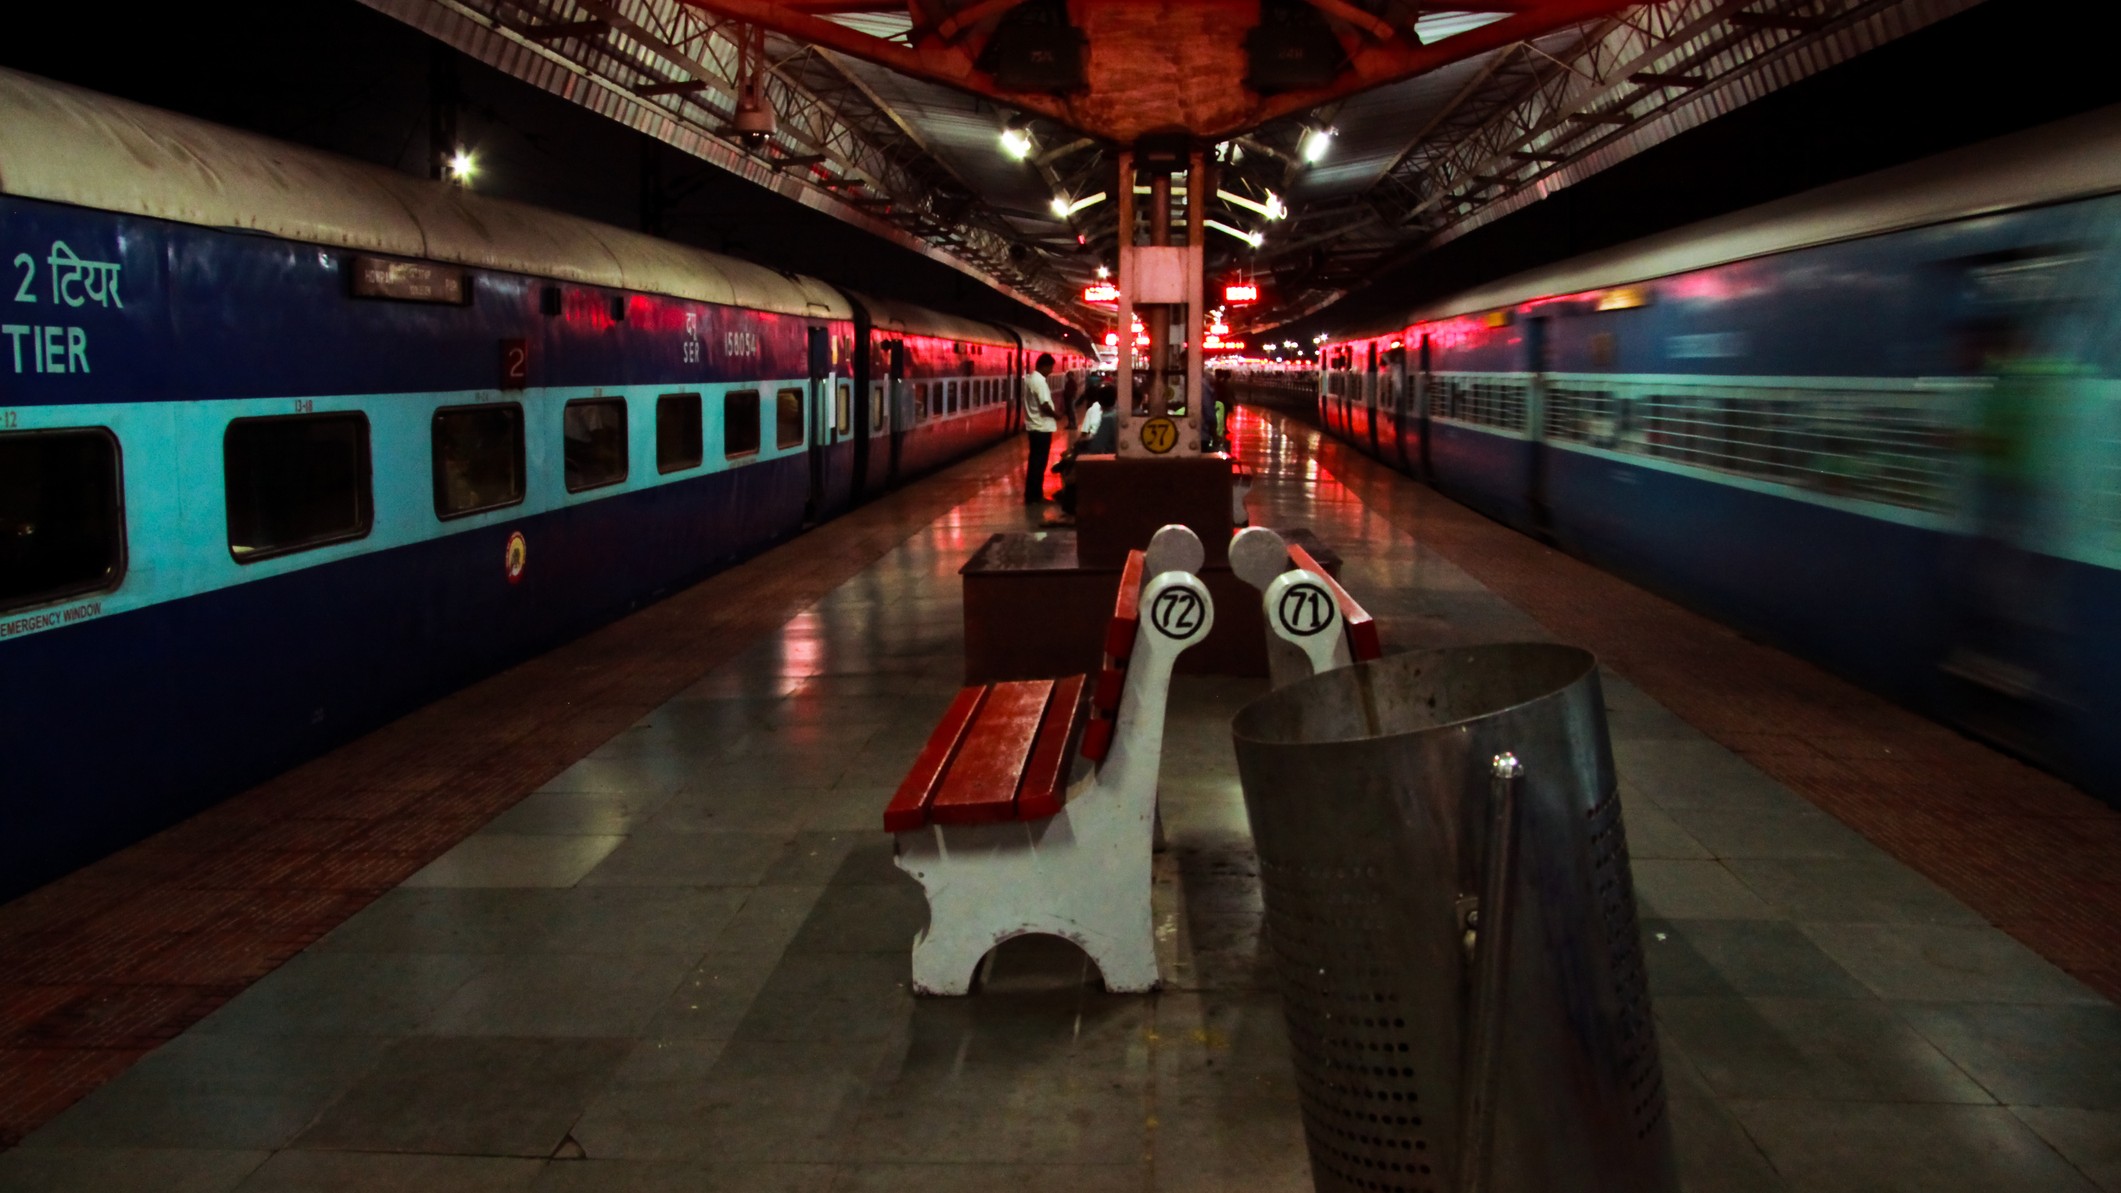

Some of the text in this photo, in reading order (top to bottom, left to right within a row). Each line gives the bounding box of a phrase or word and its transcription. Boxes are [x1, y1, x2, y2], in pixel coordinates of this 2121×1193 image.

[13, 240, 124, 309] 2 टियर
[1, 324, 91, 374] TIER
[683, 341, 700, 363] SER
[724, 331, 757, 357] 158054
[508, 347, 525, 378] 2
[1147, 424, 1169, 446] 37
[0, 603, 101, 636] EMERGENCY WINDOW
[1162, 594, 1196, 629] 72
[1290, 592, 1322, 627] 71
